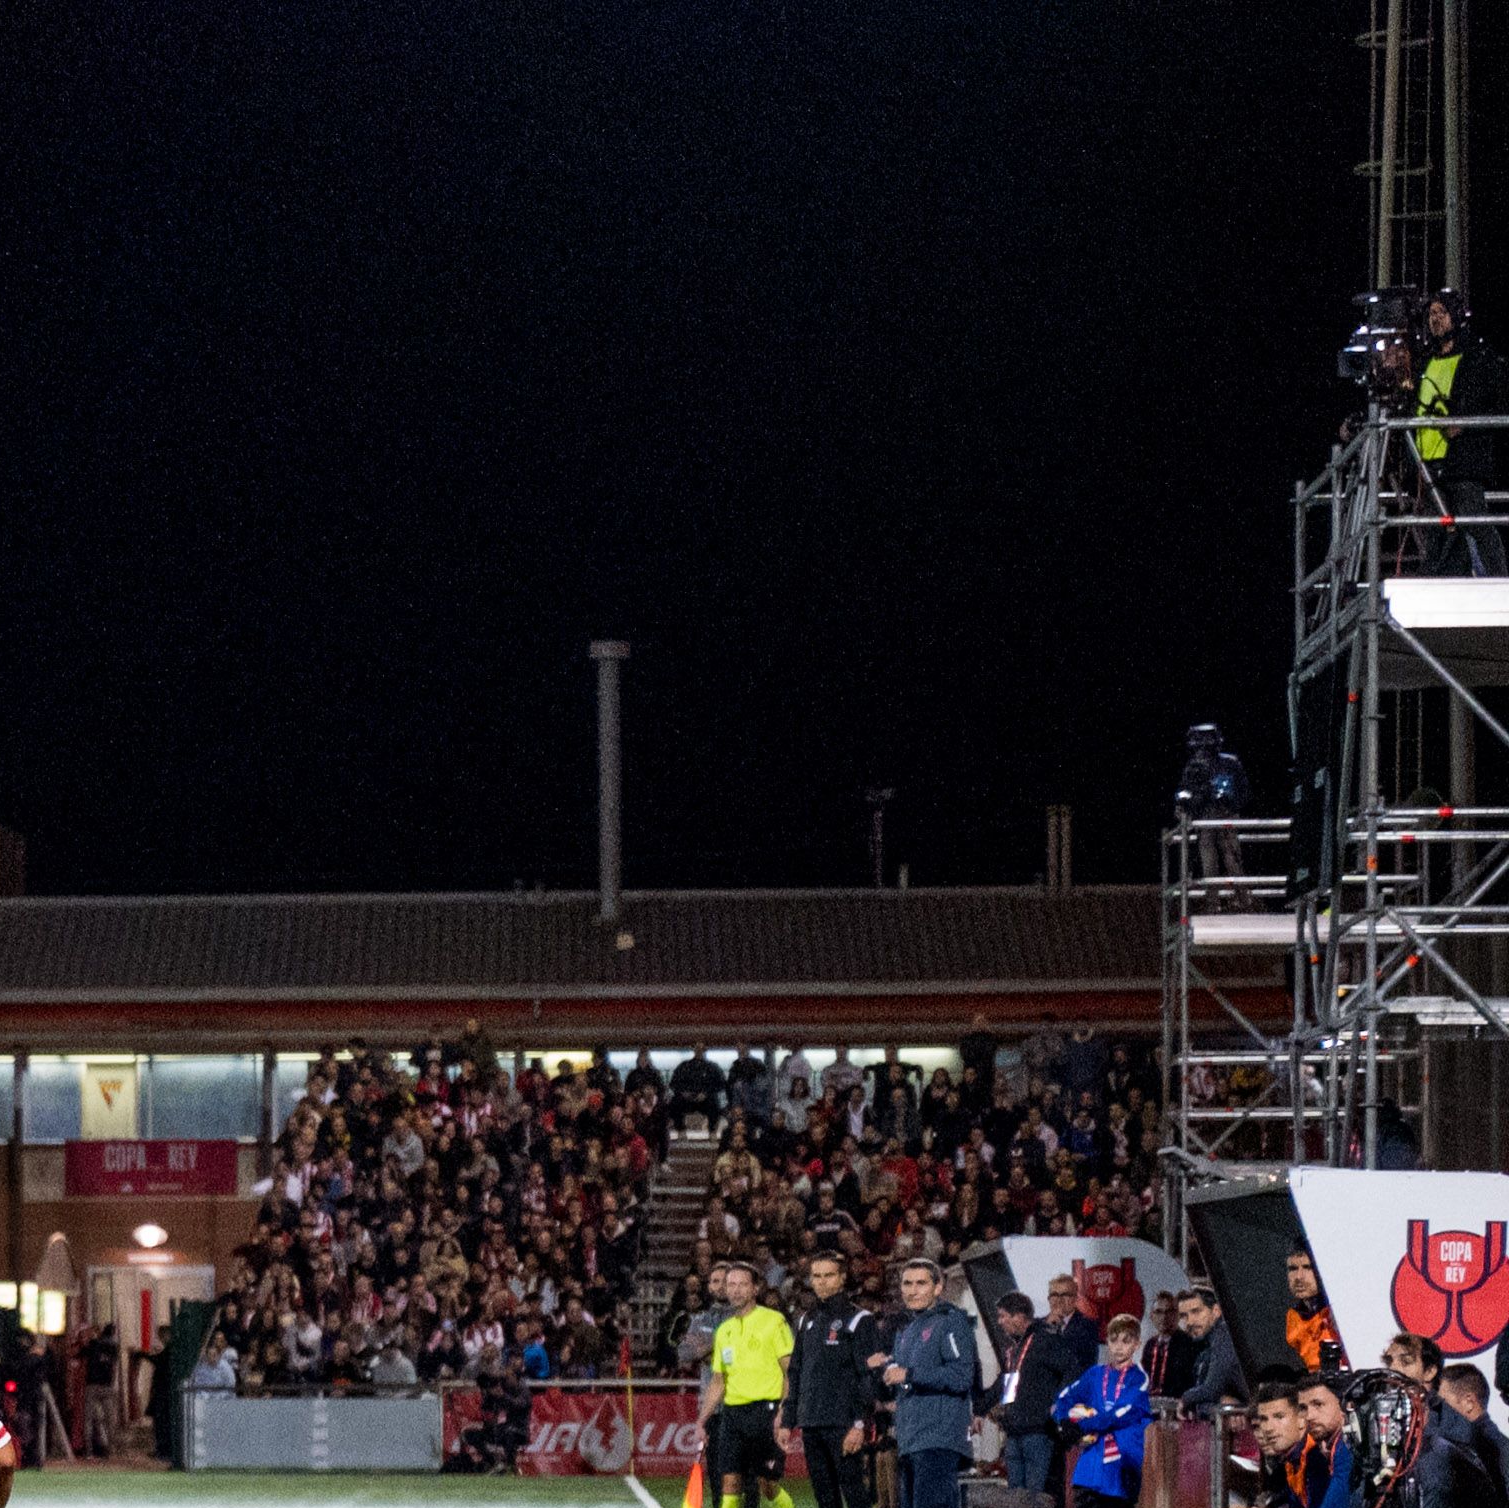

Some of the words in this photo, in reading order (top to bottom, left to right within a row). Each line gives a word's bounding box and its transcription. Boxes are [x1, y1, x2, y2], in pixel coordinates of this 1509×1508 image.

[103, 1144, 147, 1172] COPA
[1440, 1240, 1473, 1262] COPA
[1445, 1267, 1466, 1283] REY
